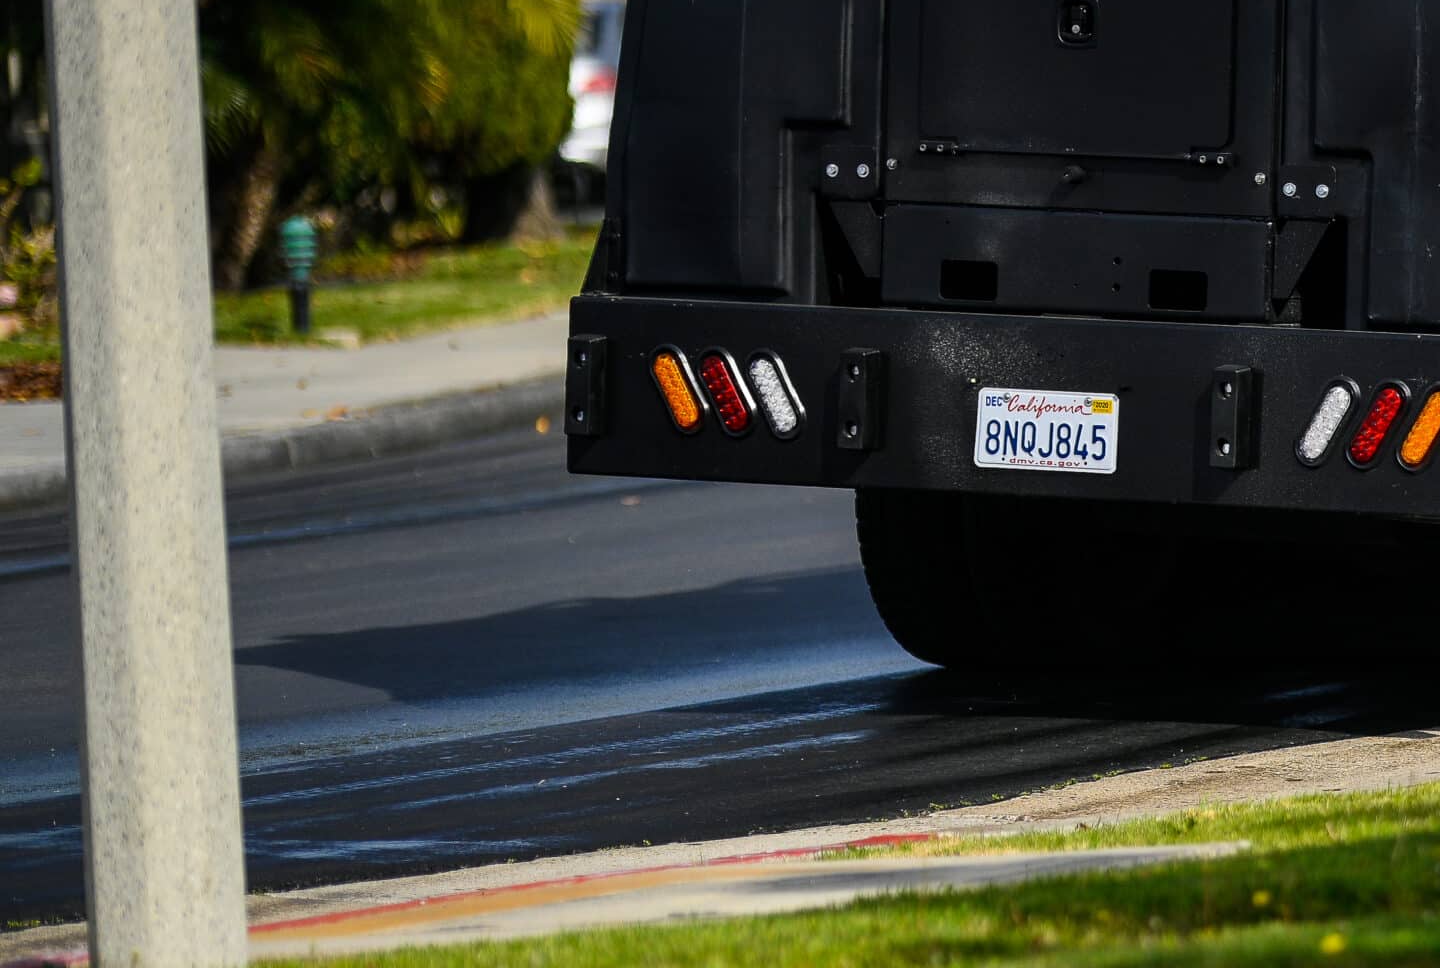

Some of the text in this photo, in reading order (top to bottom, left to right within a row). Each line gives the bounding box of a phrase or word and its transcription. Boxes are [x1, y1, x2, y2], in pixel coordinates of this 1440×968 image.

[985, 394, 1093, 419] DEC California
[984, 419, 1107, 461] 8NQJ845
[1008, 457, 1081, 468] dmv.ca.gov
